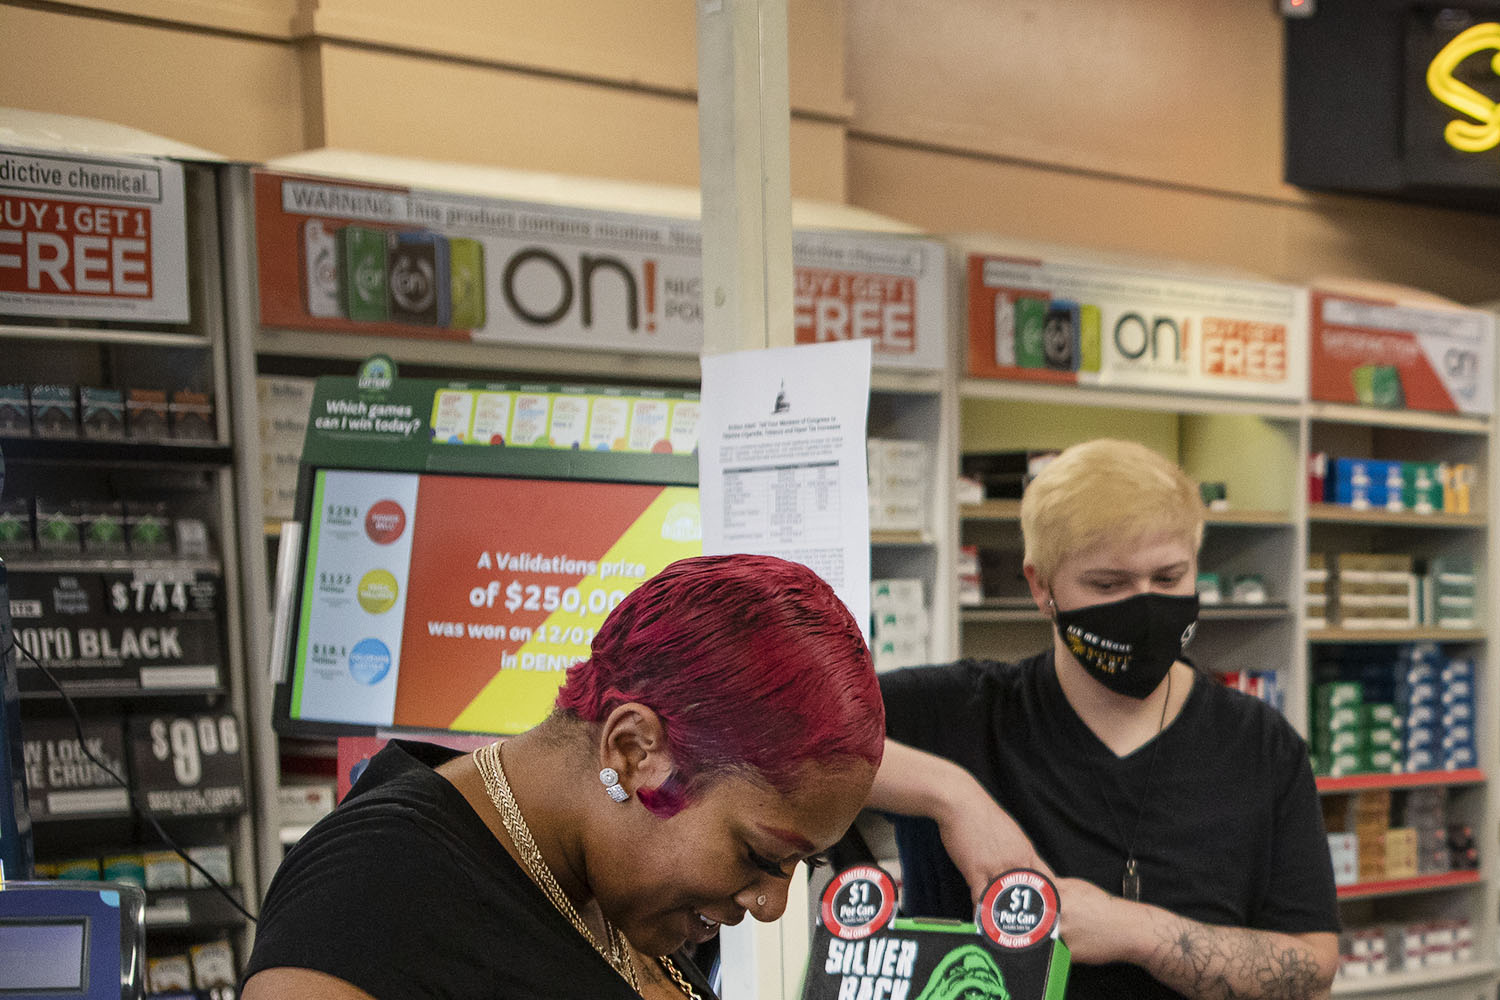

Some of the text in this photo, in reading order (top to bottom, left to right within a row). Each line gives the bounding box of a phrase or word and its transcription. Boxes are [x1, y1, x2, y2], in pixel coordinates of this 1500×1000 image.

[0, 199, 48, 229] UY
[73, 206, 129, 234] GET
[134, 211, 146, 237] 1
[0, 229, 149, 295] FREE
[503, 245, 659, 334] on!
[477, 551, 646, 579] A Validations prize
[469, 581, 500, 608] of
[79, 625, 183, 660] BLACK
[427, 621, 465, 638] was
[467, 624, 507, 640] won
[509, 626, 532, 641] on
[501, 651, 518, 669] in
[848, 882, 870, 906] $1
[1009, 887, 1032, 912] $1
[840, 904, 876, 918] Per Can
[1000, 910, 1036, 924] Per Can
[825, 937, 918, 979] SILVER
